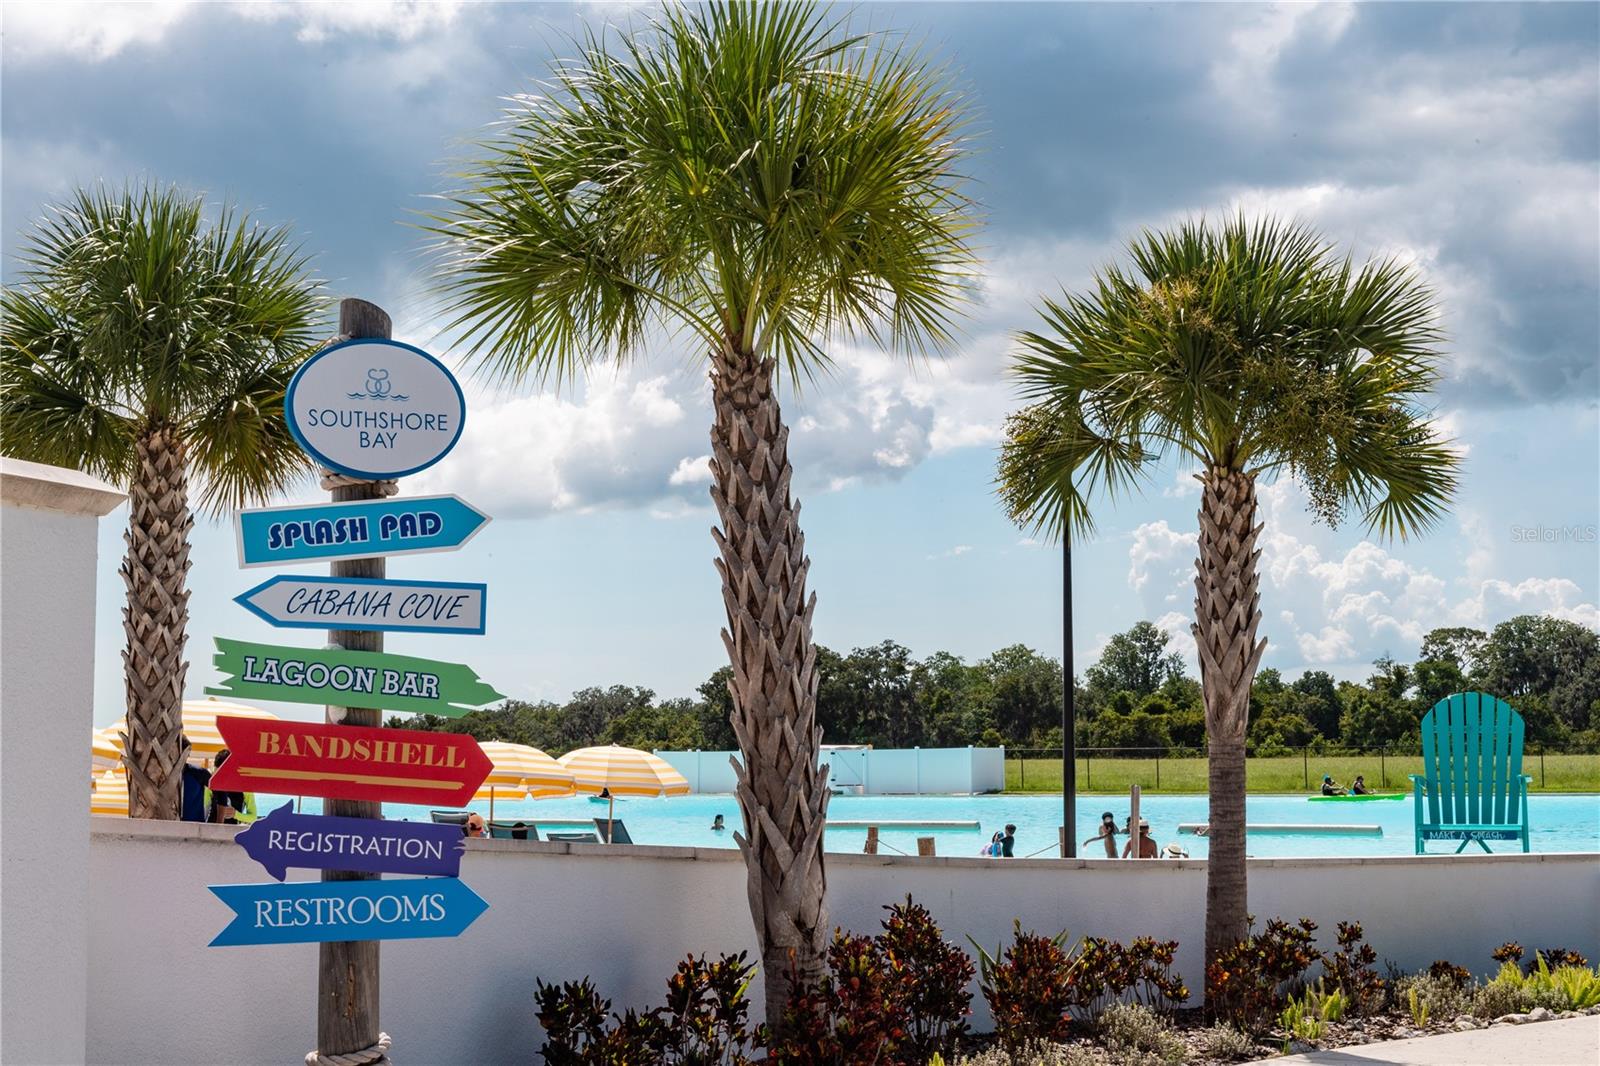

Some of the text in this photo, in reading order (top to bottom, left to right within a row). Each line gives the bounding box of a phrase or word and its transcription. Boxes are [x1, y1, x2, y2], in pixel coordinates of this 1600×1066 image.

[308, 408, 448, 431] SOUTHSHORE
[359, 432, 398, 448] BAY
[268, 512, 443, 549] SPLASH PAD
[286, 588, 469, 620] CABANA COVE
[243, 656, 440, 698] LAGOON BAR
[258, 731, 466, 769] BANDSHELL
[268, 829, 443, 860] REGISTRATION
[1429, 831, 1456, 840] MAKE
[1459, 831, 1467, 840] A
[254, 893, 446, 928] RESTROOMS
